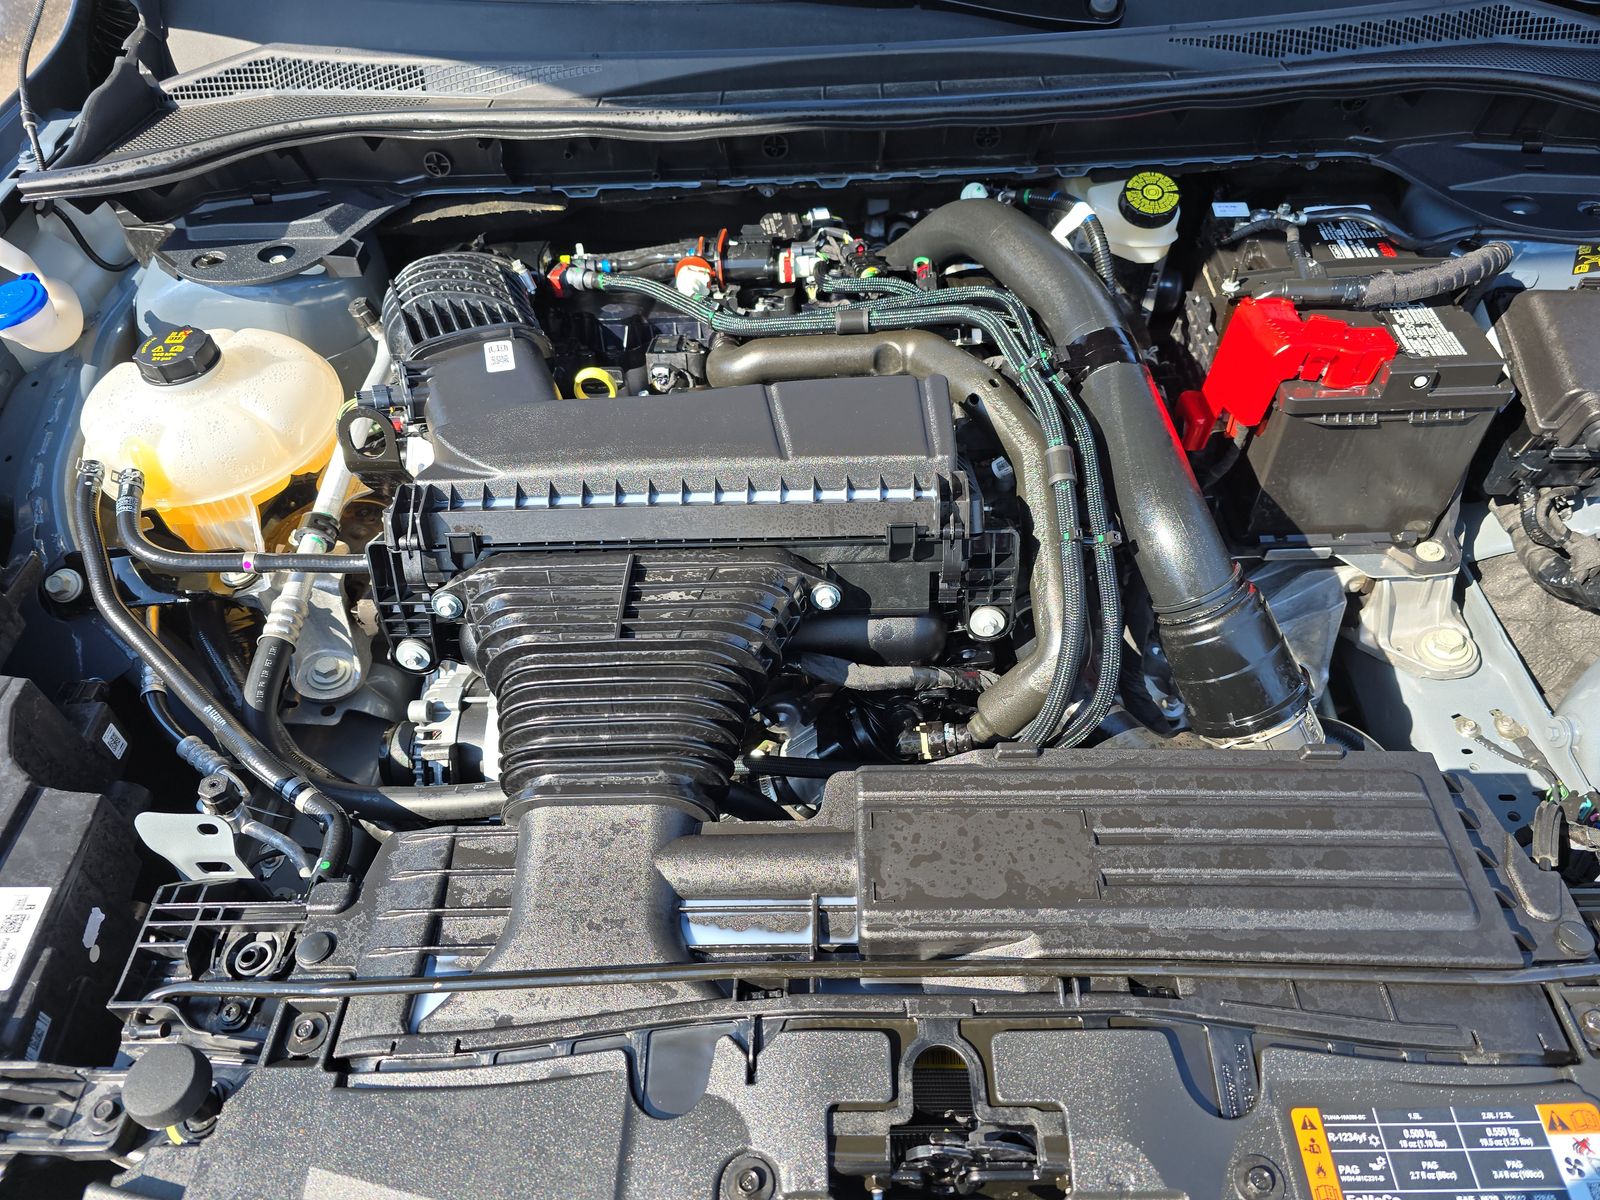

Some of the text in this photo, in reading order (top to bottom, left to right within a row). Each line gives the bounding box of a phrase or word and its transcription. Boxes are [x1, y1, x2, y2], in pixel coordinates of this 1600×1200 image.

[264, 658, 273, 668] PET
[1403, 1128, 1437, 1140] 0.500 kg
[1486, 1127, 1520, 1138] 0.550 kg
[1327, 1132, 1367, 1144] R-1234yf
[1503, 1138, 1520, 1147] (1.21
[1520, 1137, 1533, 1147] lbs)
[1417, 1139, 1434, 1149] (1.10
[1433, 1139, 1447, 1149] lbs)
[1421, 1161, 1439, 1170] PAG
[1505, 1160, 1523, 1169] PAG
[1337, 1165, 1360, 1175] PAG
[1492, 1170, 1504, 1179] 3.4
[1519, 1170, 1544, 1180] (100cc)
[1409, 1171, 1420, 1180] 2.7
[1427, 1172, 1436, 1180] oz
